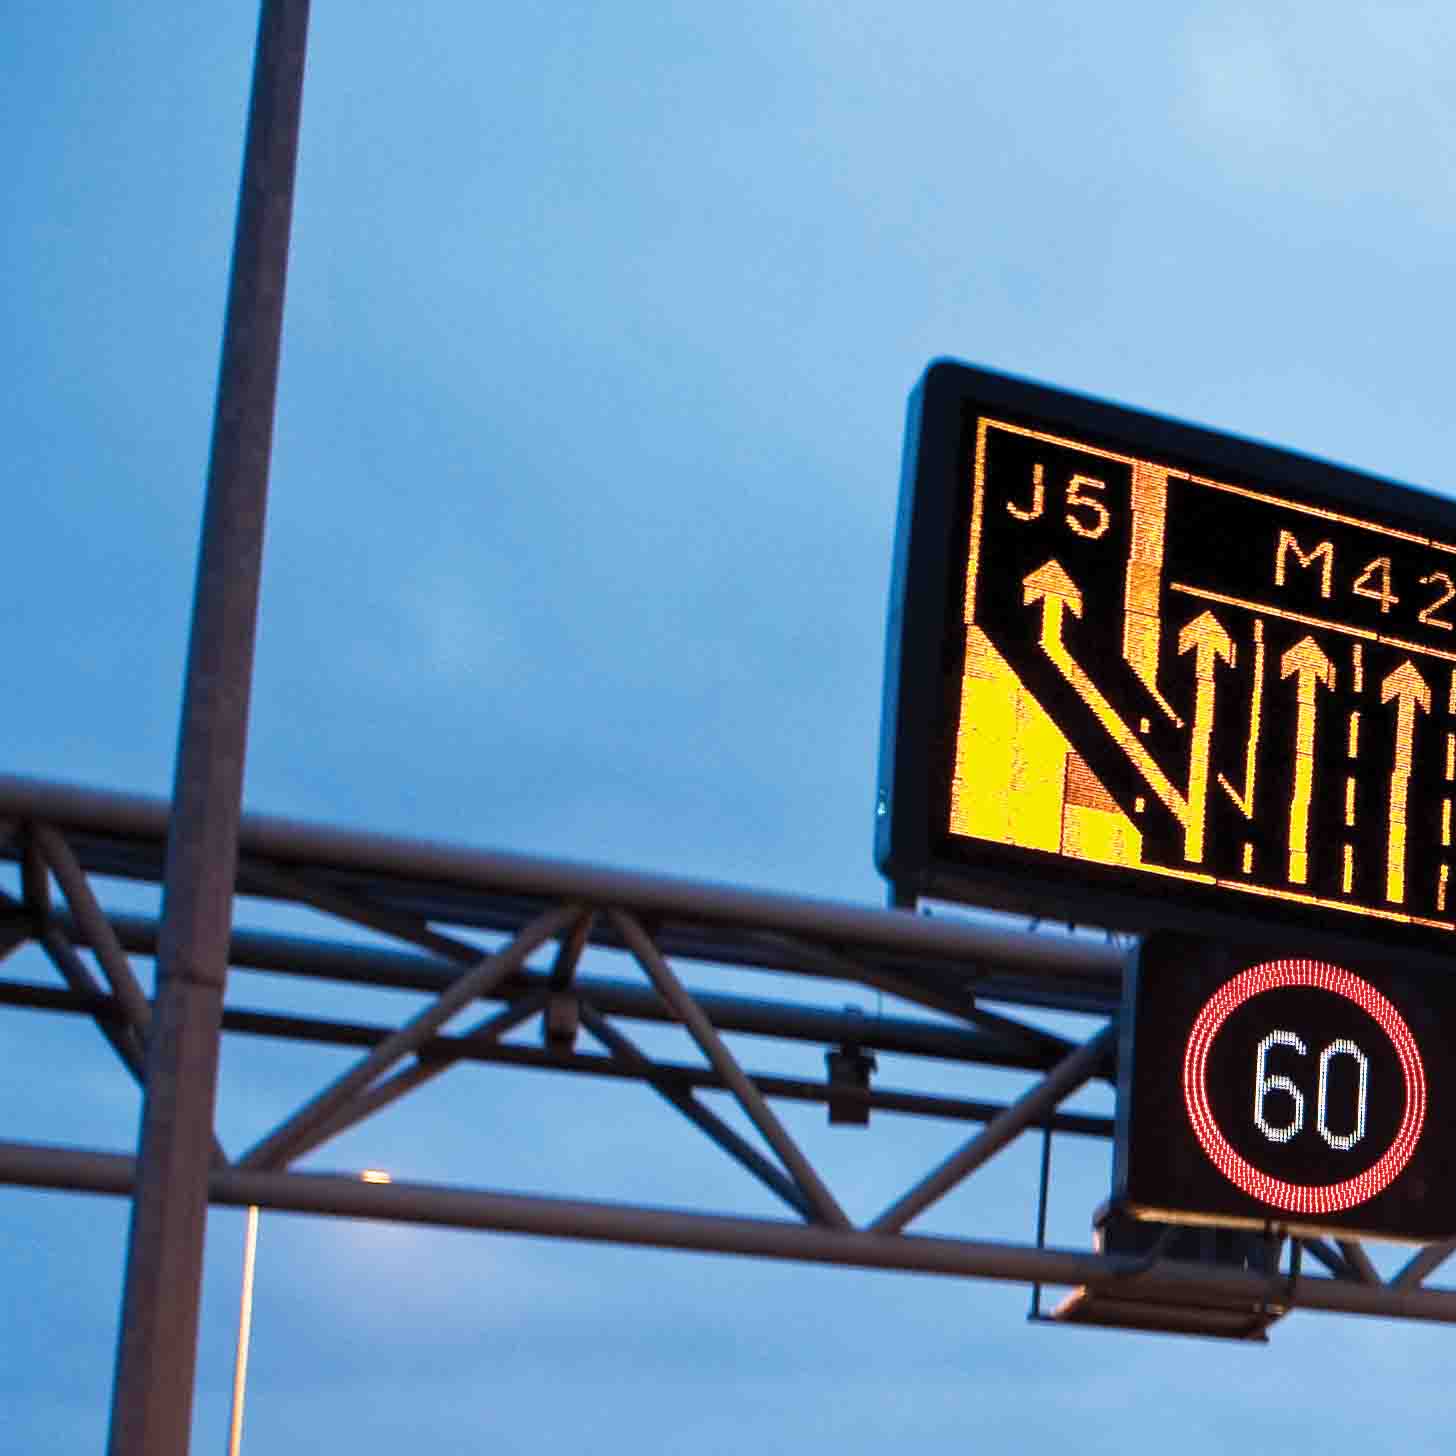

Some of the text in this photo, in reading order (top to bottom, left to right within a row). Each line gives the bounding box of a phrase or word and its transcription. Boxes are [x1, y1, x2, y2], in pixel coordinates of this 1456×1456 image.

[1006, 463, 1111, 541] J5
[1274, 530, 1456, 631] M42
[1252, 1029, 1370, 1152] 60
